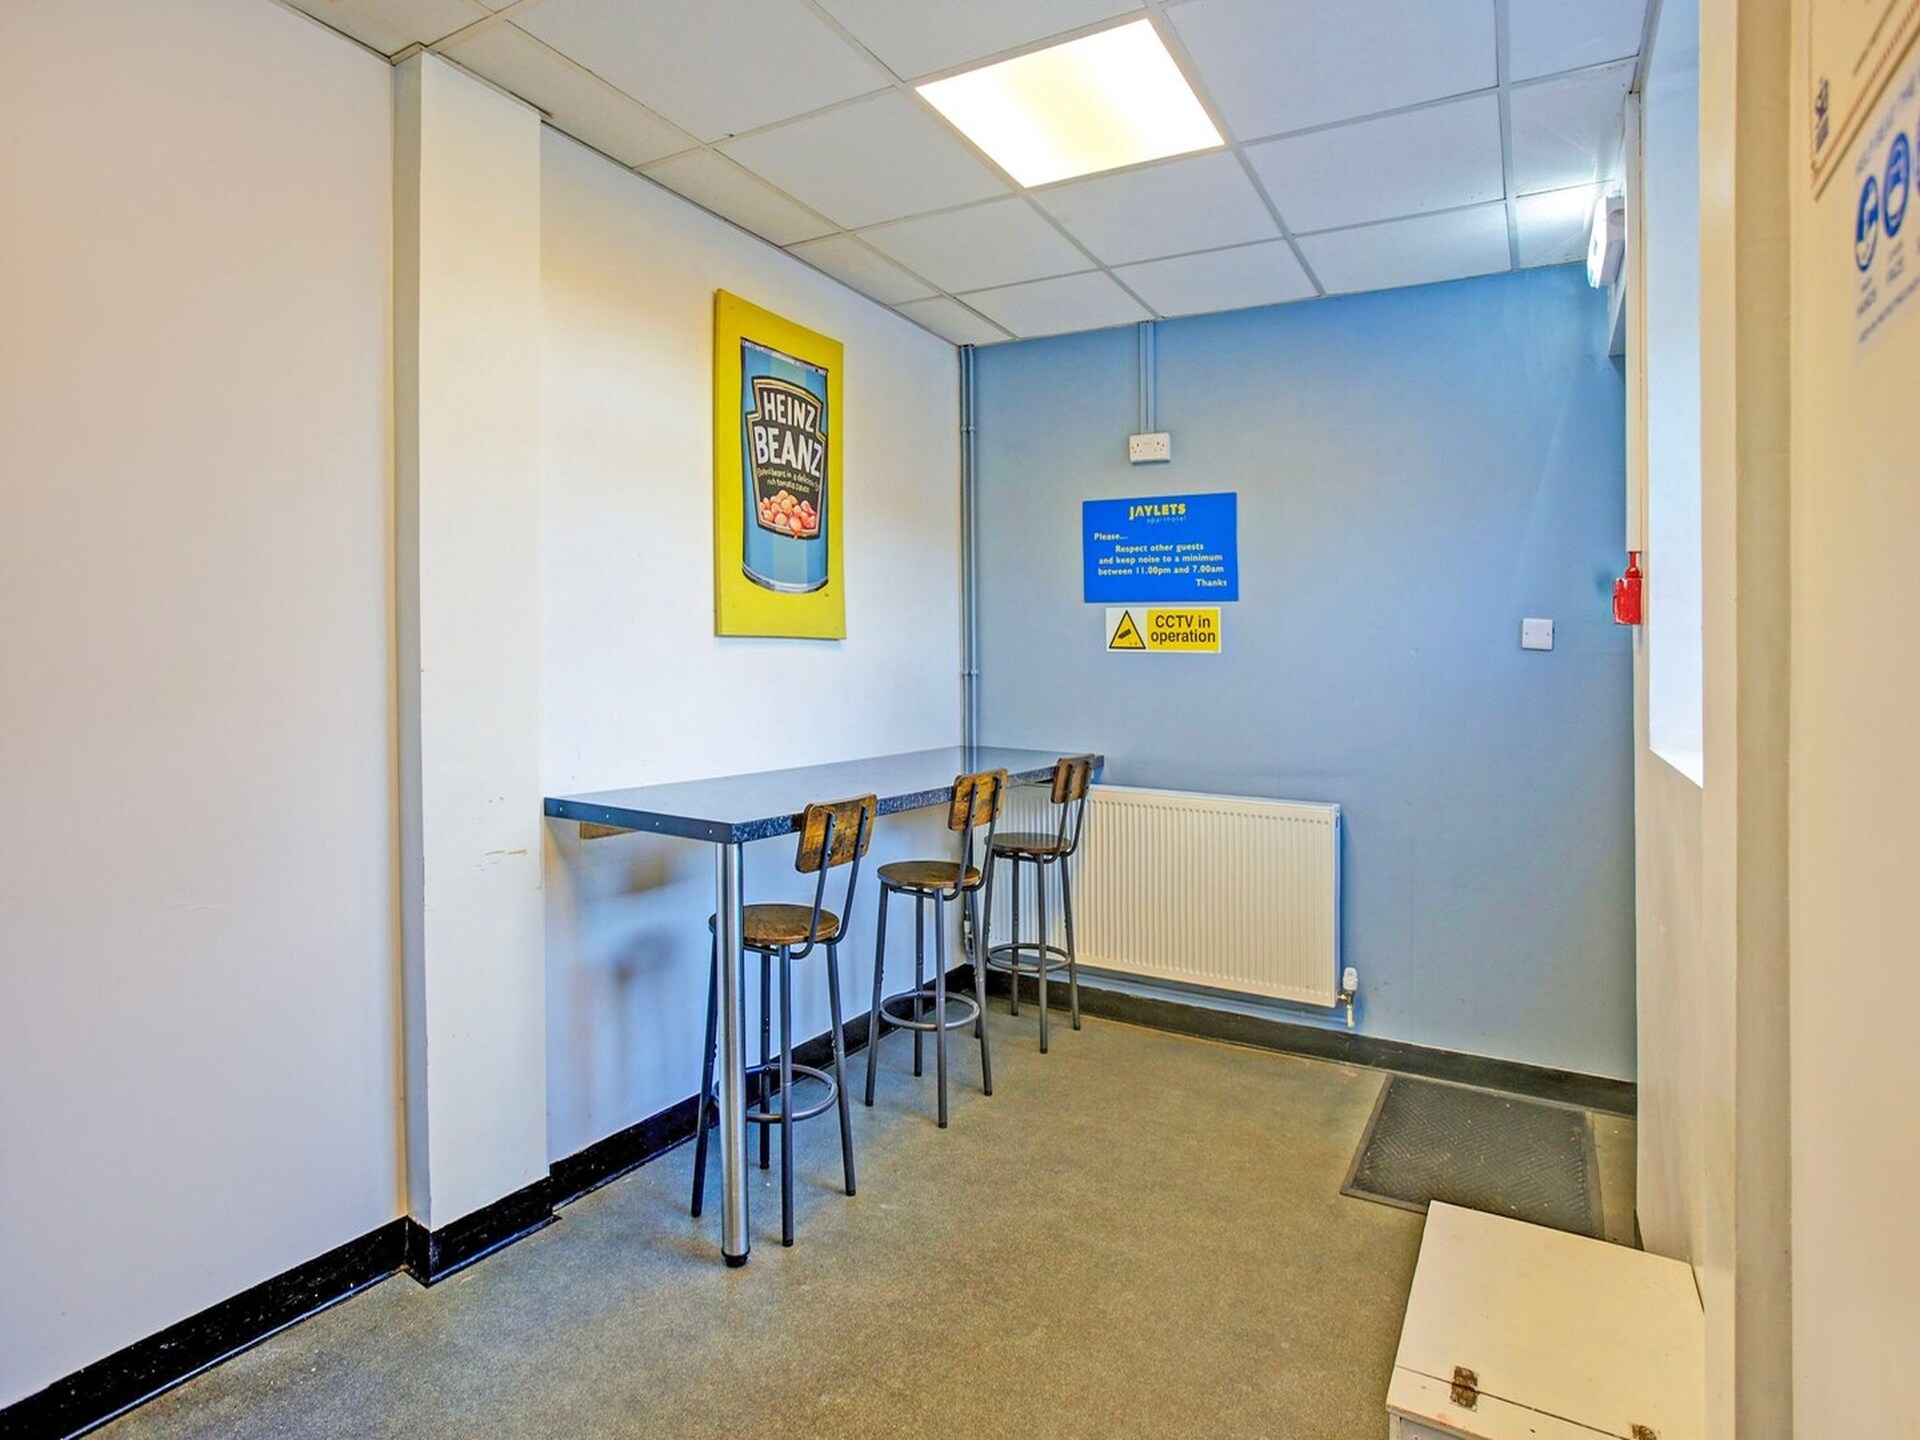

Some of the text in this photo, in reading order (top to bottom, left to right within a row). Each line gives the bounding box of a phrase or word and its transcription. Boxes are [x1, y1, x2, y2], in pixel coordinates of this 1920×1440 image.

[763, 391, 816, 433] HEINZ
[754, 425, 823, 477] BEANZ
[1129, 503, 1186, 520] JAYLETS
[1115, 543, 1204, 554] Respect other guests
[1098, 557, 1114, 565] and
[1115, 556, 1136, 566] keep
[1138, 555, 1160, 563] noise
[1182, 554, 1223, 562] minimum
[1098, 565, 1224, 576] between 11.00pm and 7.00am
[1196, 578, 1228, 587] Thanks
[1155, 614, 1211, 628] CCTV in
[1150, 629, 1216, 645] operation
